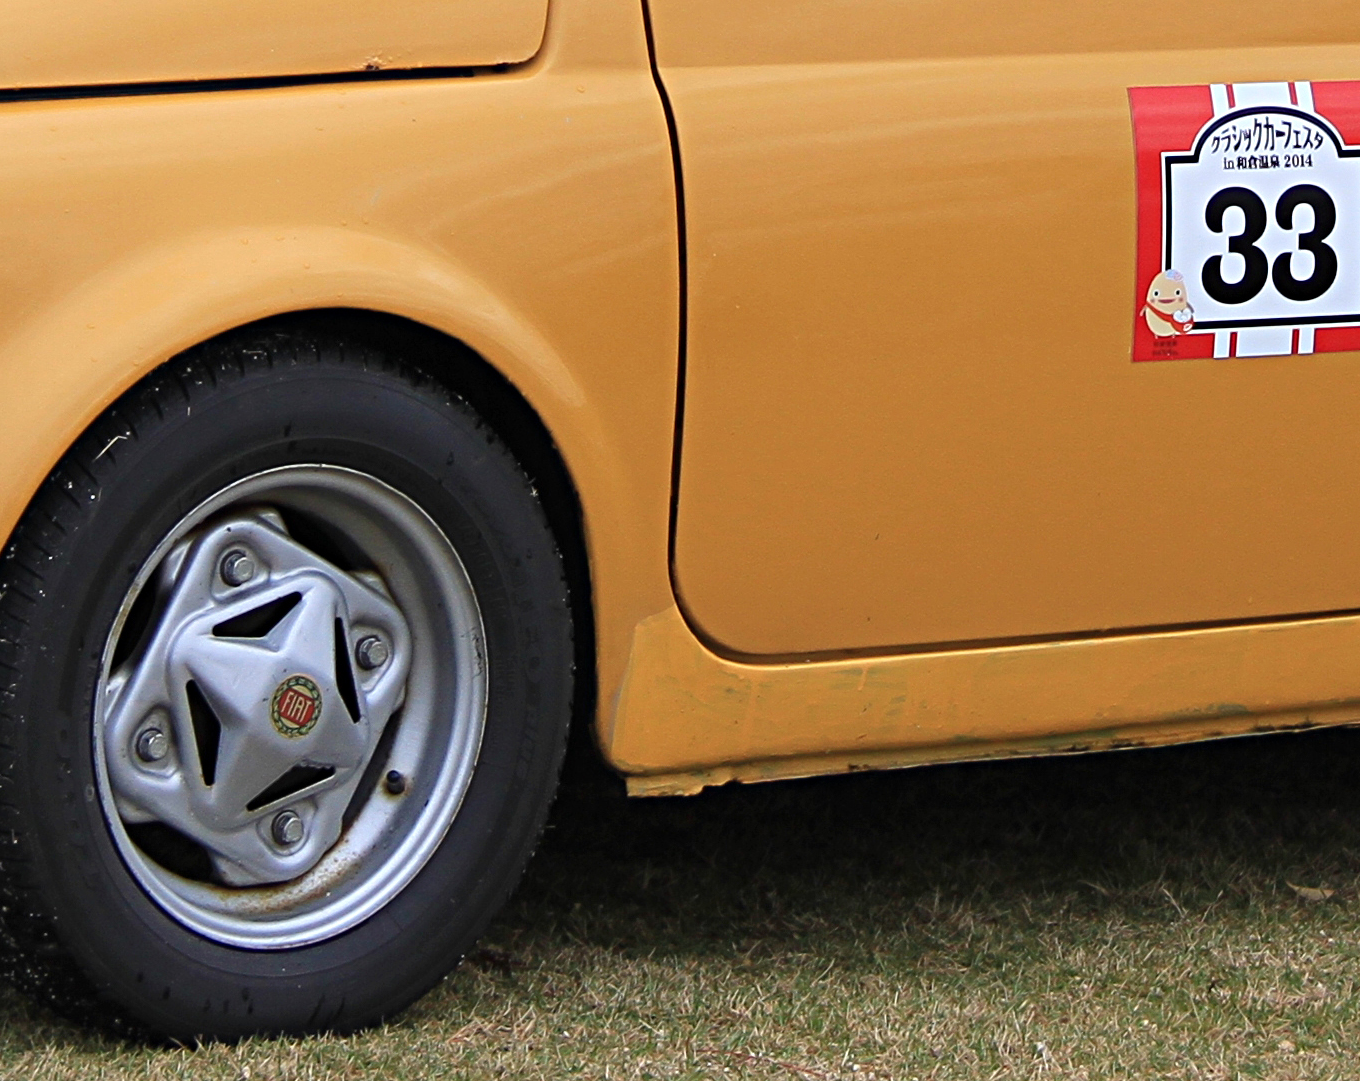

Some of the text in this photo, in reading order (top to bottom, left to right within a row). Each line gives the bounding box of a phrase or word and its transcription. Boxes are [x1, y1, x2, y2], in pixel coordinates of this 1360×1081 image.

[1211, 116, 1324, 154] クラシックカーフェスタ
[1223, 157, 1235, 170] in
[1284, 154, 1313, 168] 2014
[1201, 184, 1338, 305] 33
[281, 691, 312, 723] FIAT
